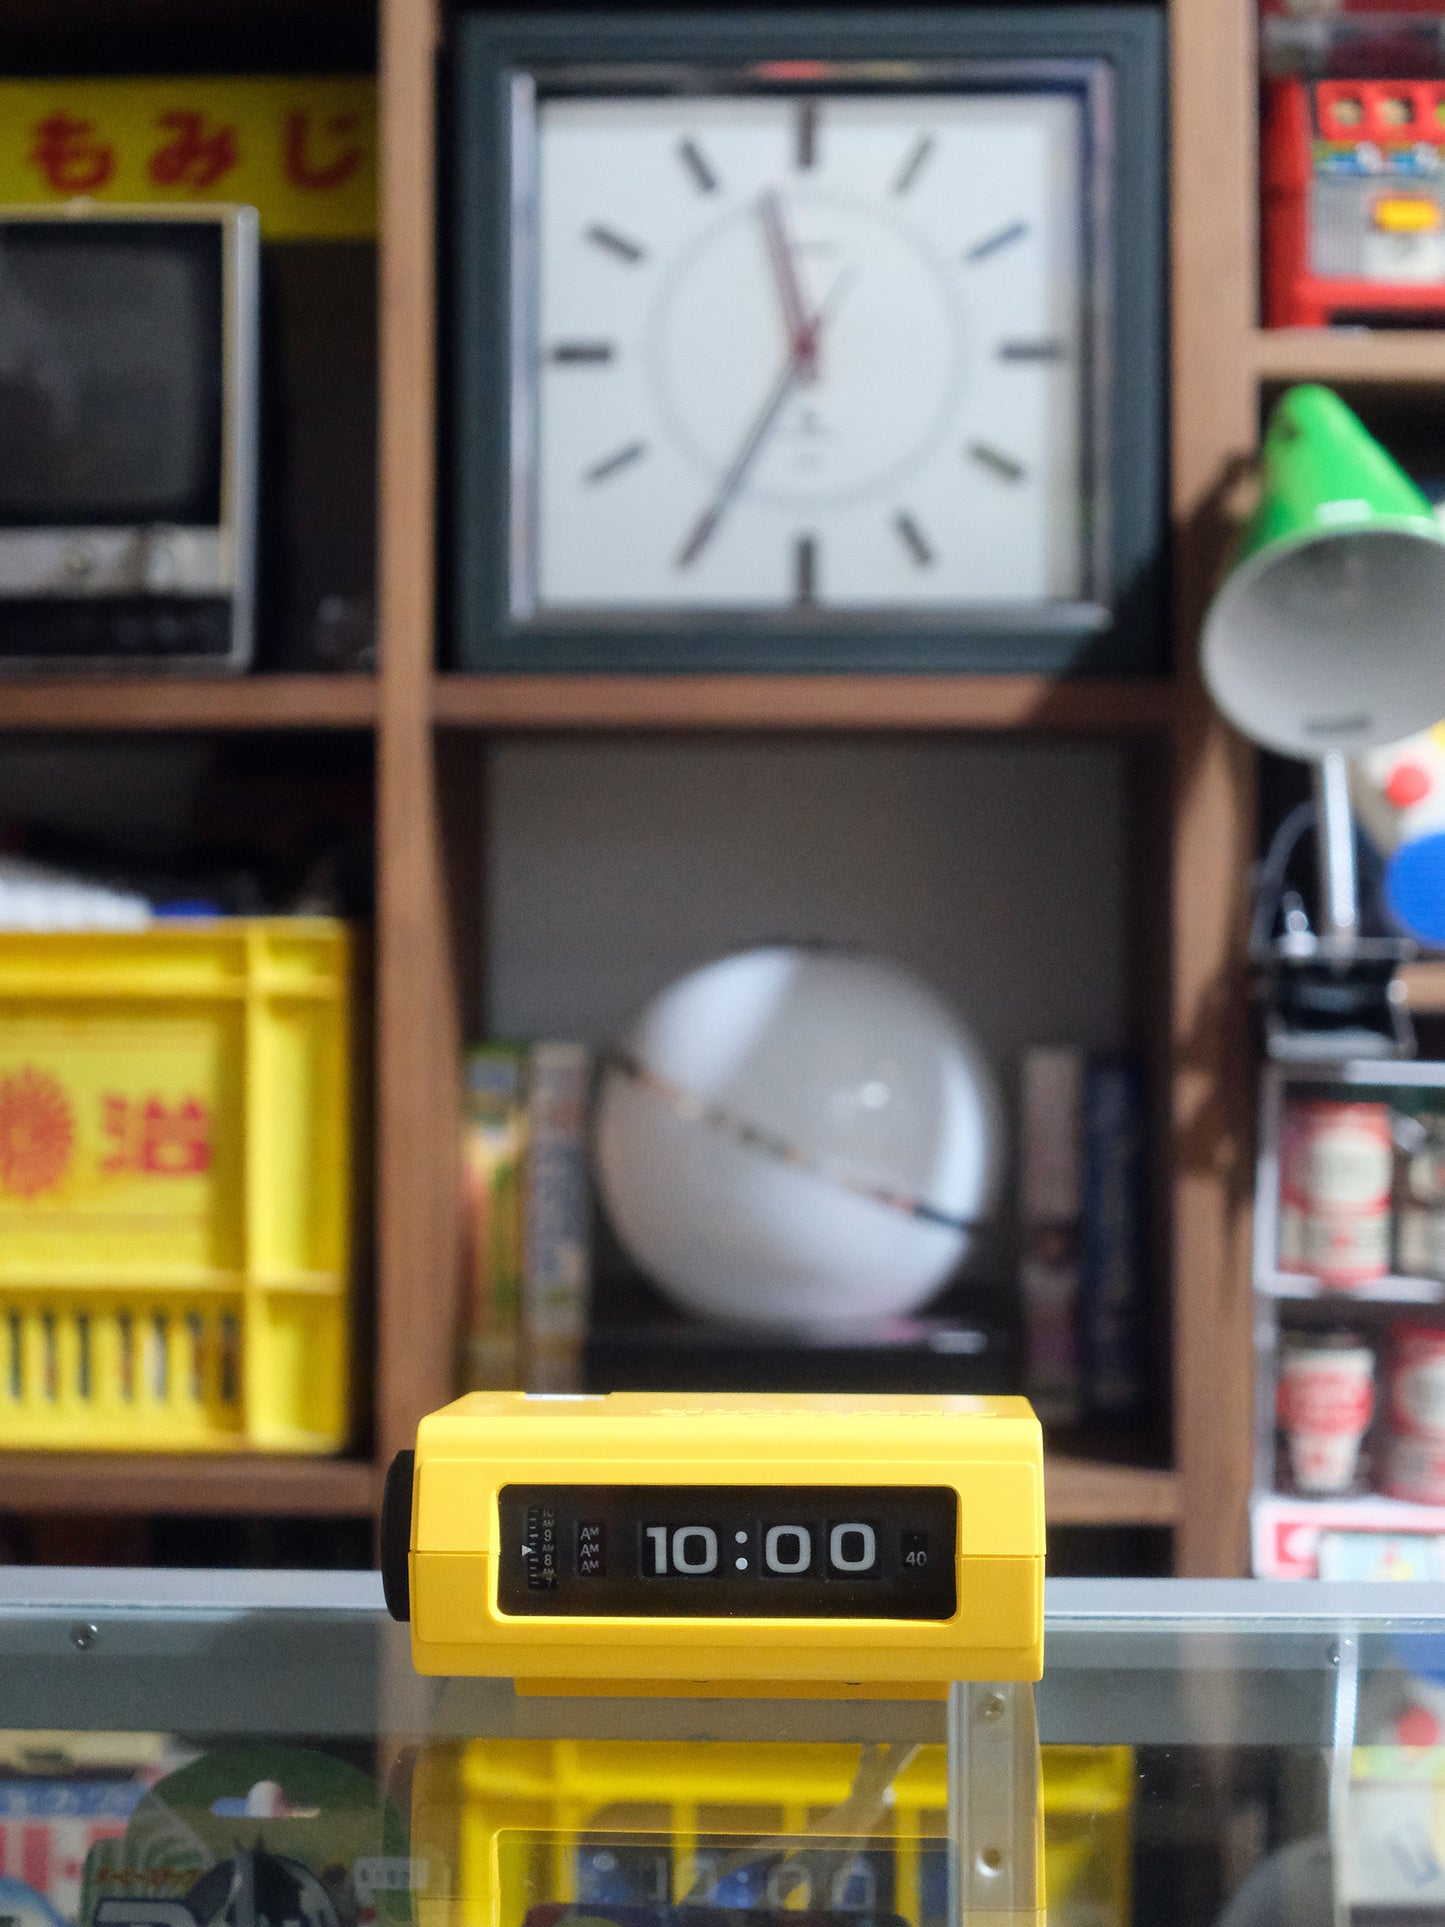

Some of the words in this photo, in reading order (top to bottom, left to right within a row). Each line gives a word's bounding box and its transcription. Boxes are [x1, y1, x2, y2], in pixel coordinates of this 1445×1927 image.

[32, 111, 361, 191] もみじ
[544, 1530, 552, 1541] 9
[580, 1527, 599, 1540] AM
[580, 1544, 599, 1557] AM
[647, 1523, 876, 1575] 10:00
[544, 1554, 552, 1566] 8
[906, 1550, 927, 1567] 40
[580, 1560, 599, 1573] AM
